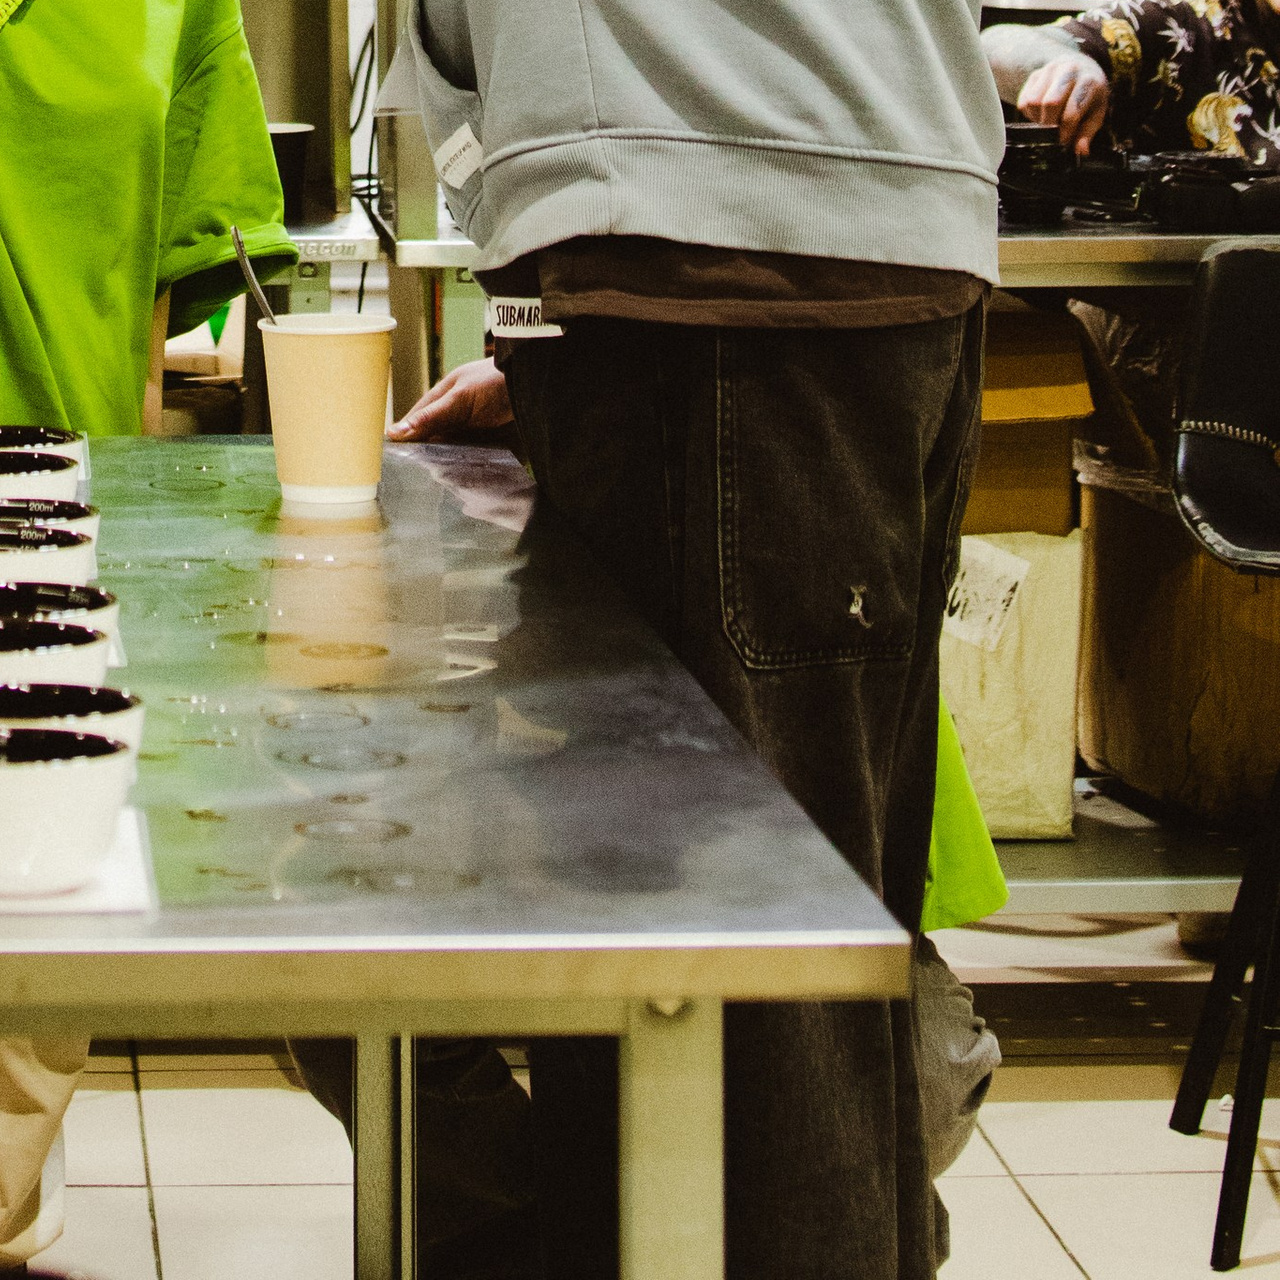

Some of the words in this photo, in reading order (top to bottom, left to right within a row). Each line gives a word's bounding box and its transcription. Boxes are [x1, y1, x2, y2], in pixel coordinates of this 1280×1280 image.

[496, 304, 549, 328] SUBMAR
[29, 502, 54, 512] 200ml
[20, 529, 46, 540] 200ml
